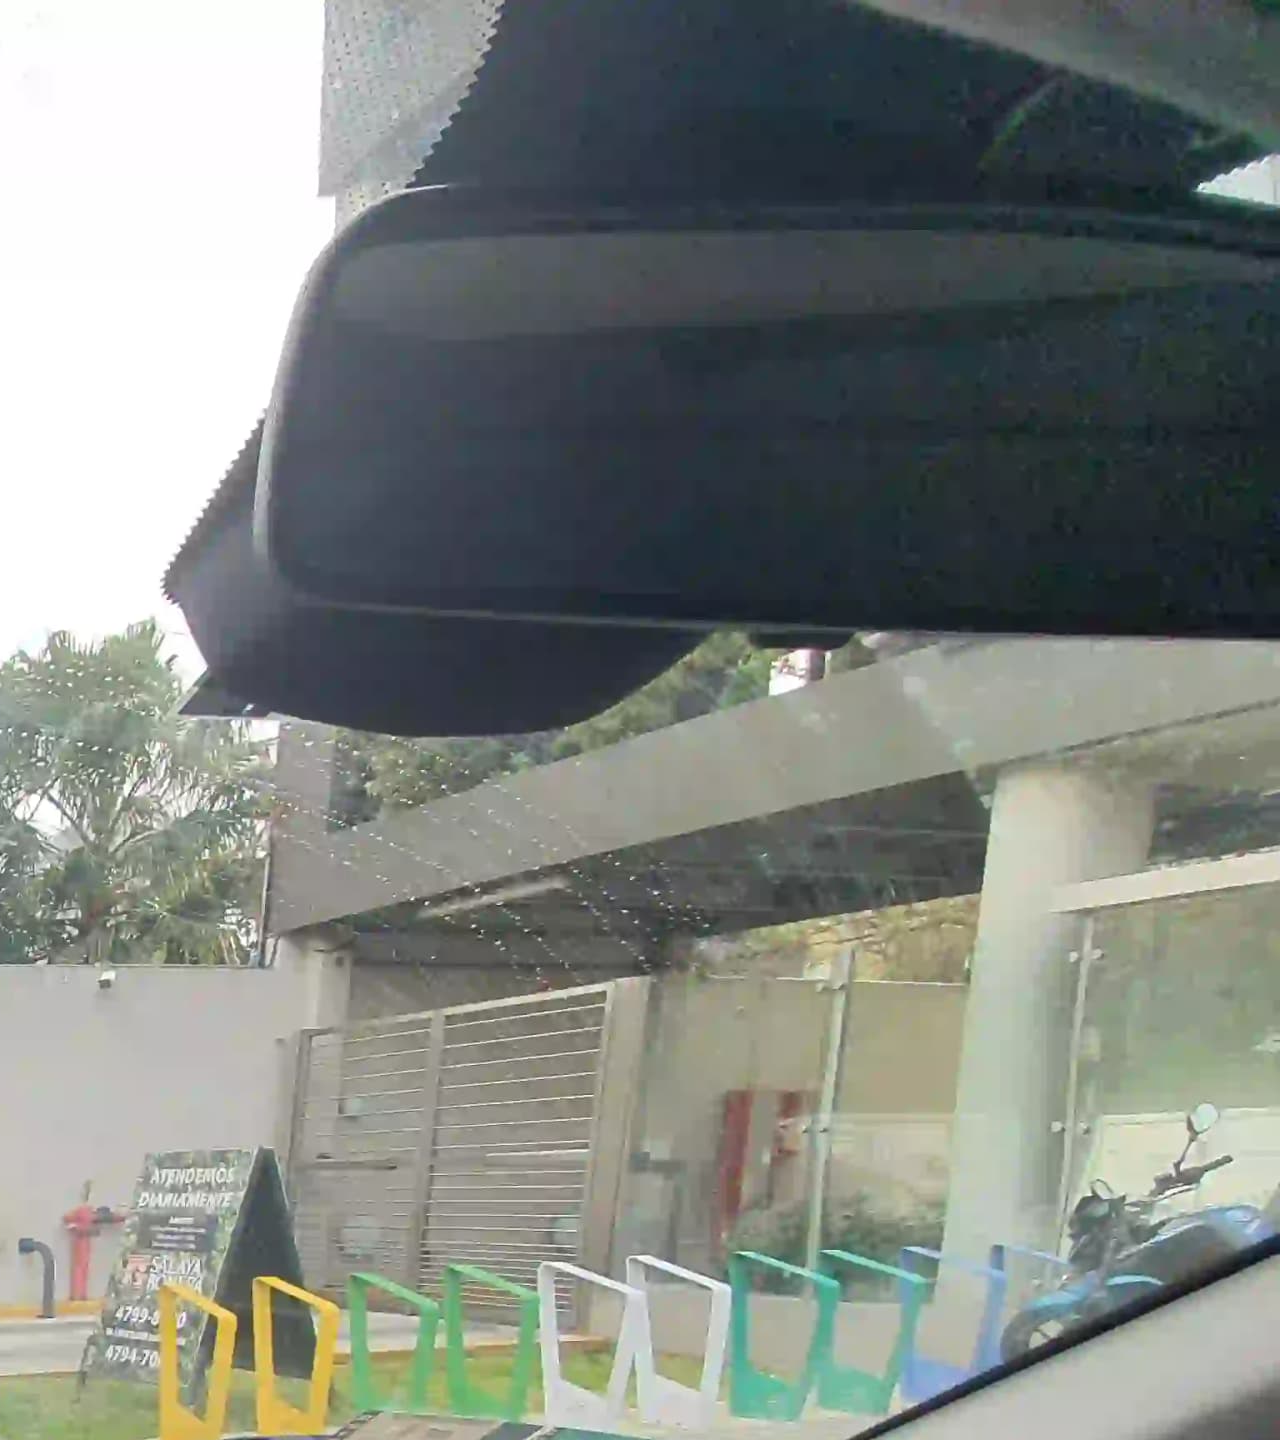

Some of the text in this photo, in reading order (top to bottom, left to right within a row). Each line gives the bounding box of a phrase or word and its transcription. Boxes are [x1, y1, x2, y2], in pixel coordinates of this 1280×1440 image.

[151, 1167, 234, 1184] ATENDEMOS
[139, 1192, 233, 1208] DIARIAMENTE
[115, 1305, 187, 1329] 4799-80
